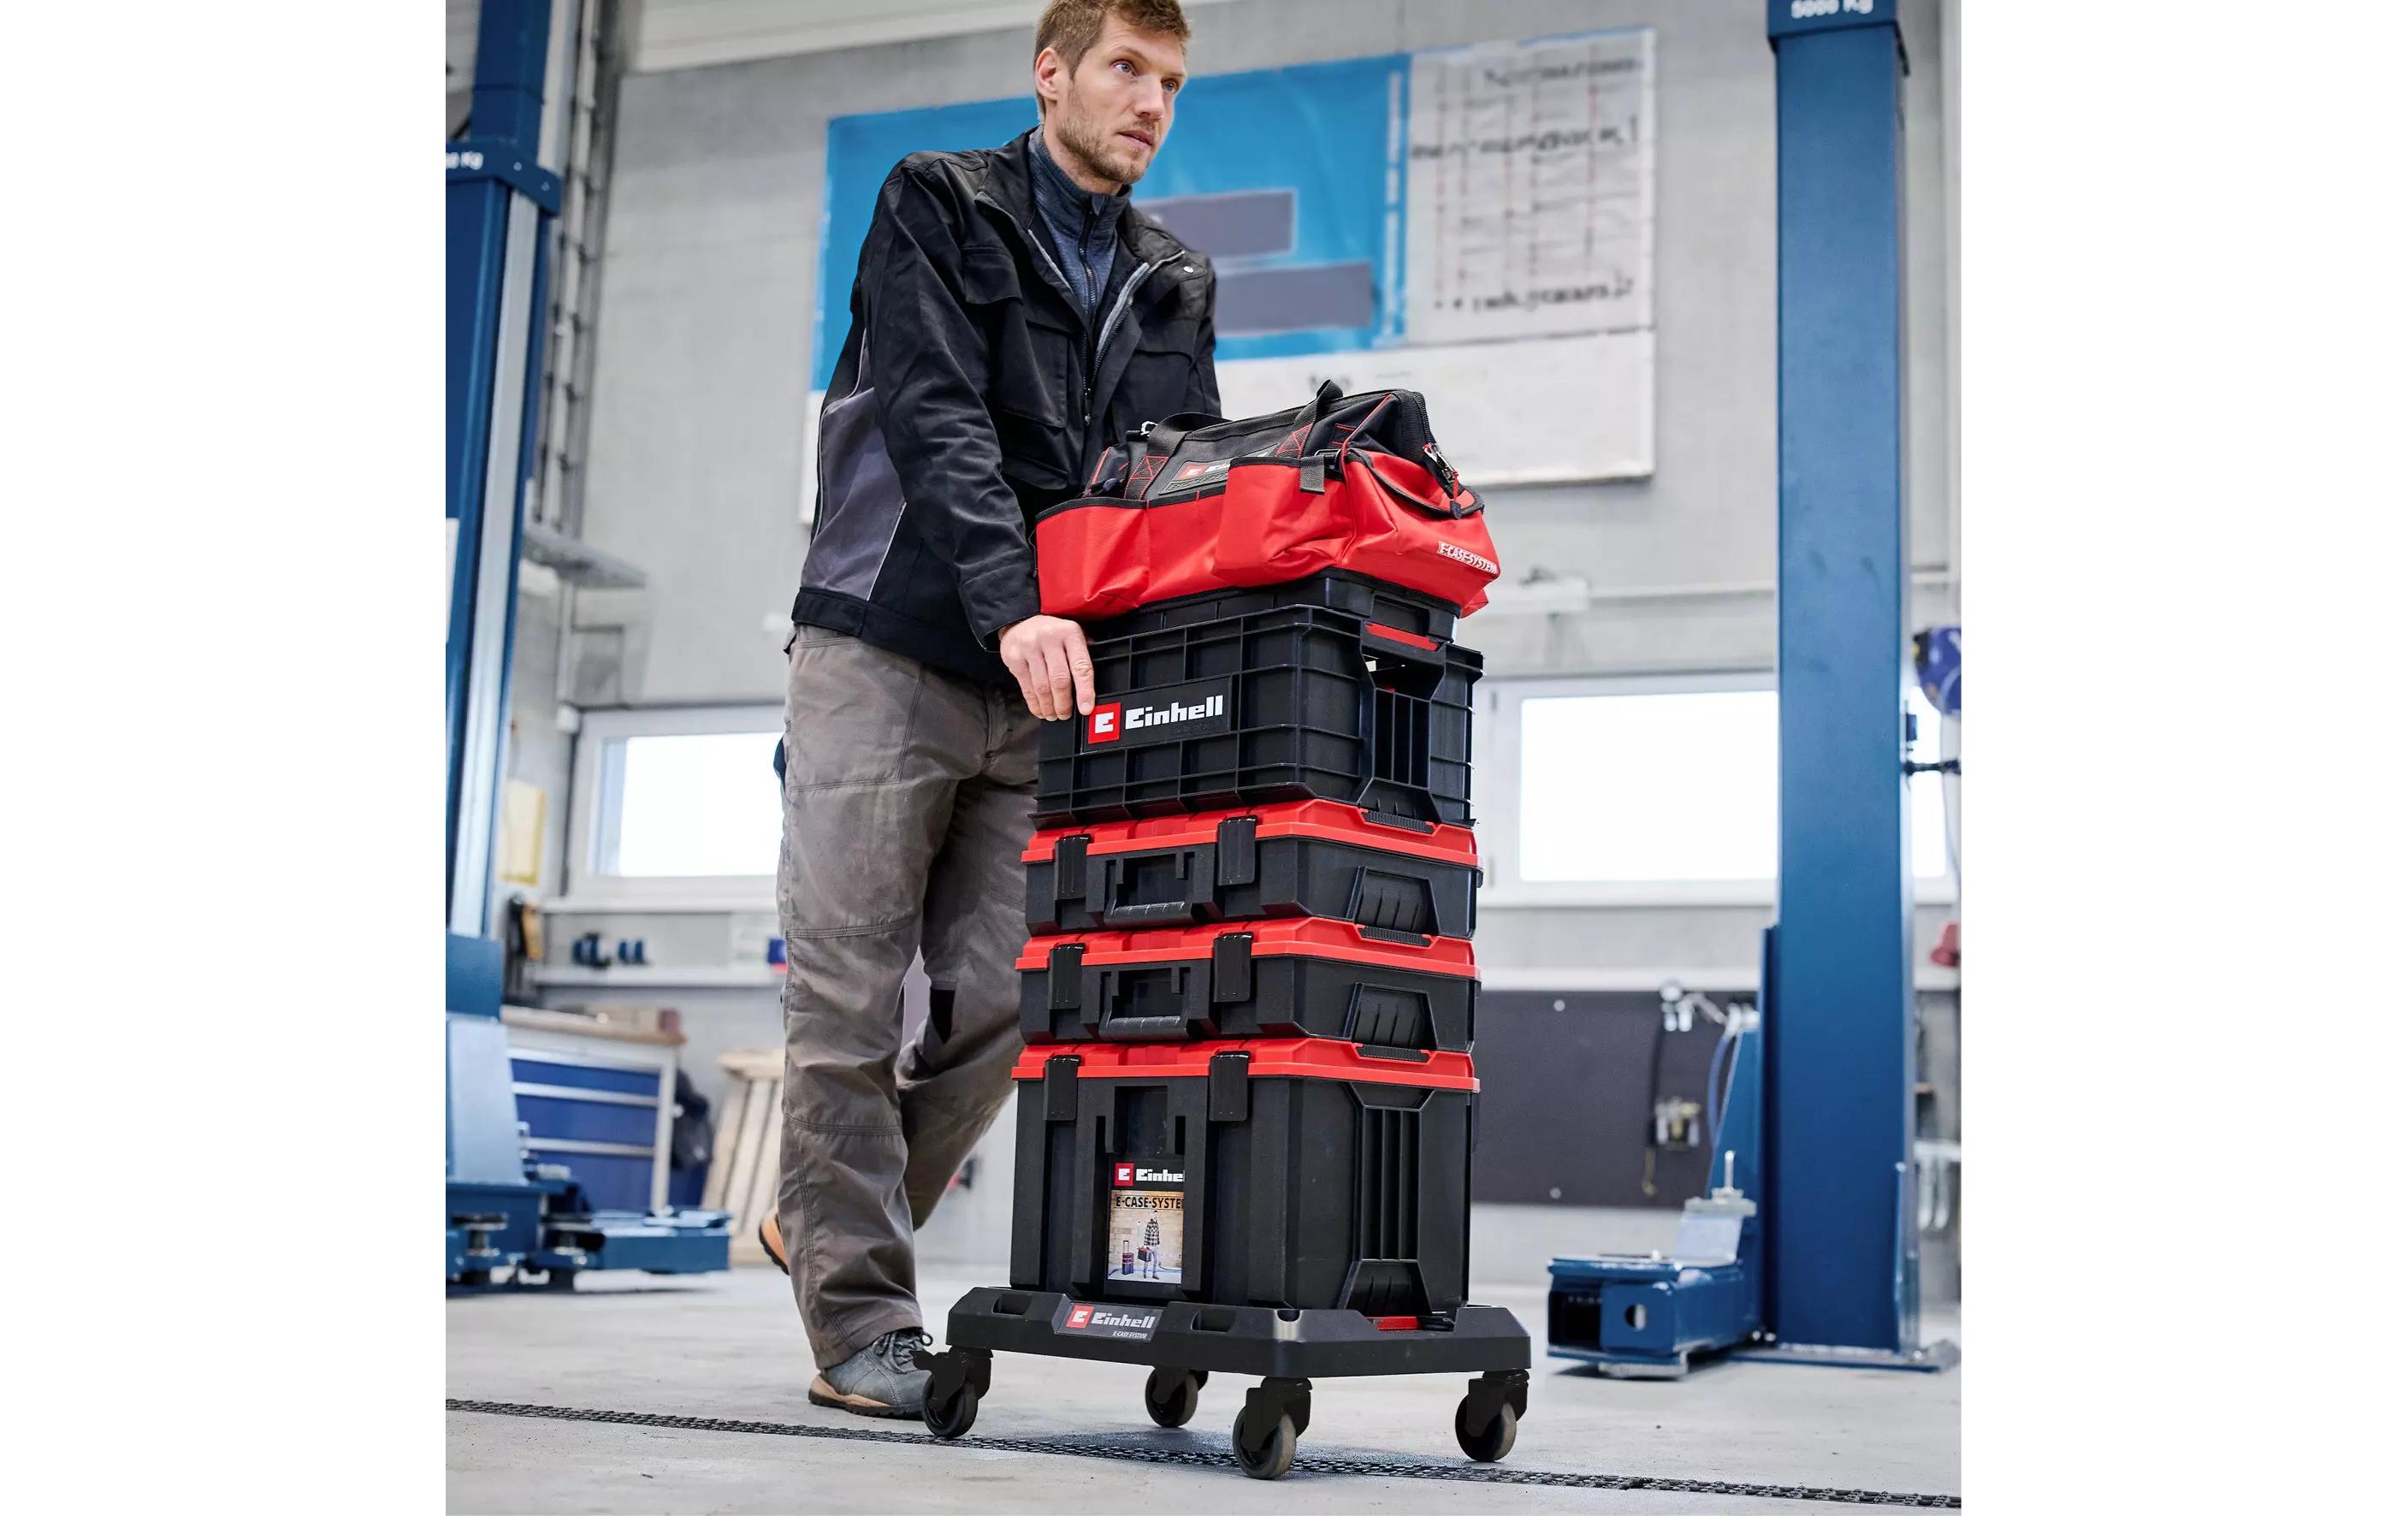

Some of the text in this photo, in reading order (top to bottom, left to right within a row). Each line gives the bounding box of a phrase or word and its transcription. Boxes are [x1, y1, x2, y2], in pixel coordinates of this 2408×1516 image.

[1125, 695, 1223, 730] Einhell
[1115, 1196, 1184, 1209] E-CASE-SYSTE
[1091, 1312, 1156, 1329] Einhell
